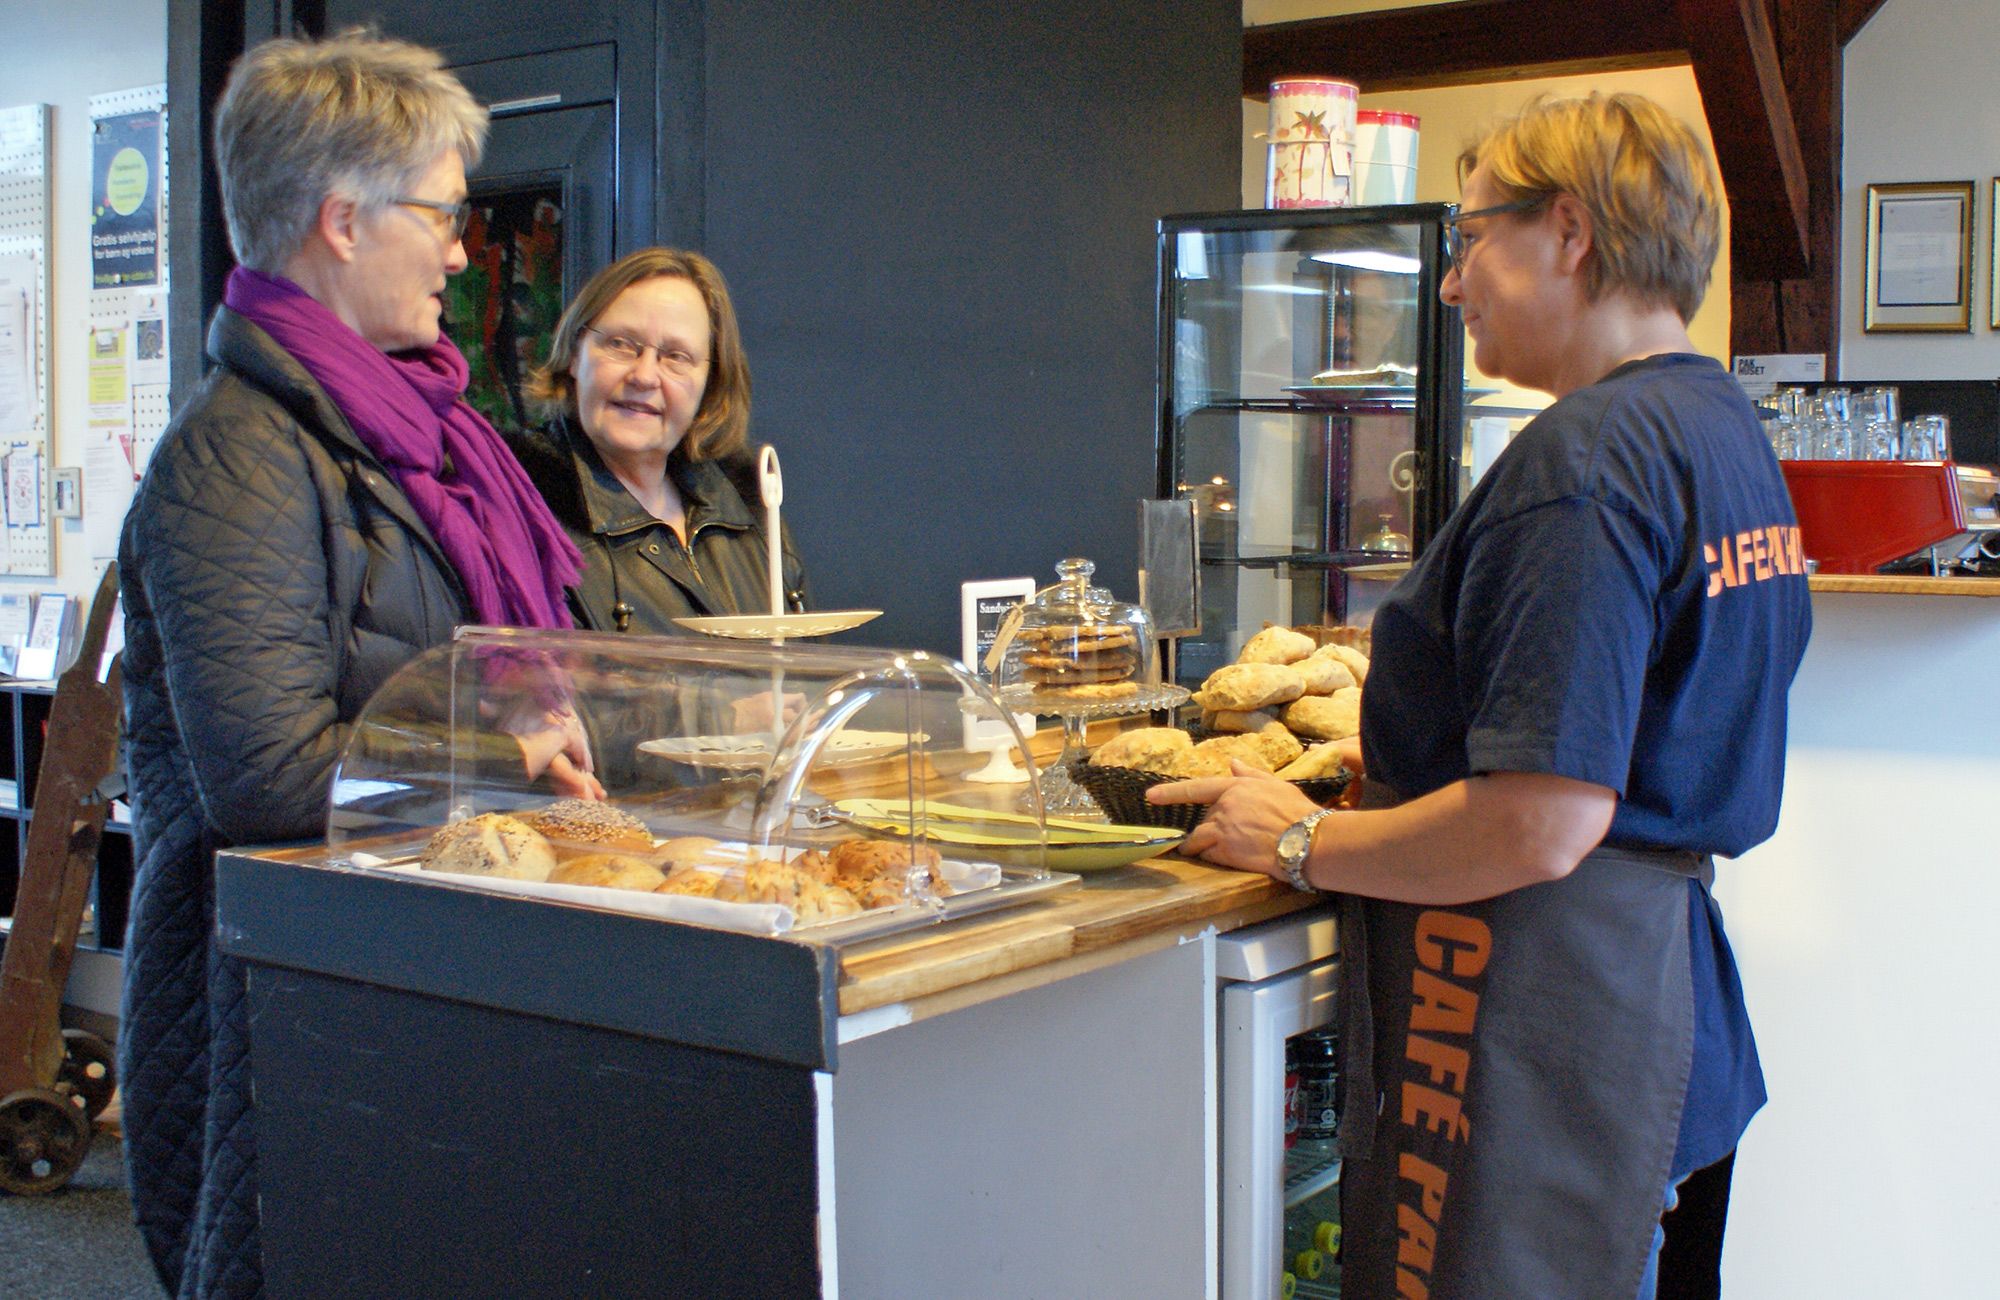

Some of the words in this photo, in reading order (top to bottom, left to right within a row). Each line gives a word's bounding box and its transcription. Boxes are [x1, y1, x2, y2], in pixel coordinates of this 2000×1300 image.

[1739, 358, 1756, 367] PAK
[1738, 366, 1765, 376] HUSET
[1401, 910, 1493, 1146] CAFÉ
